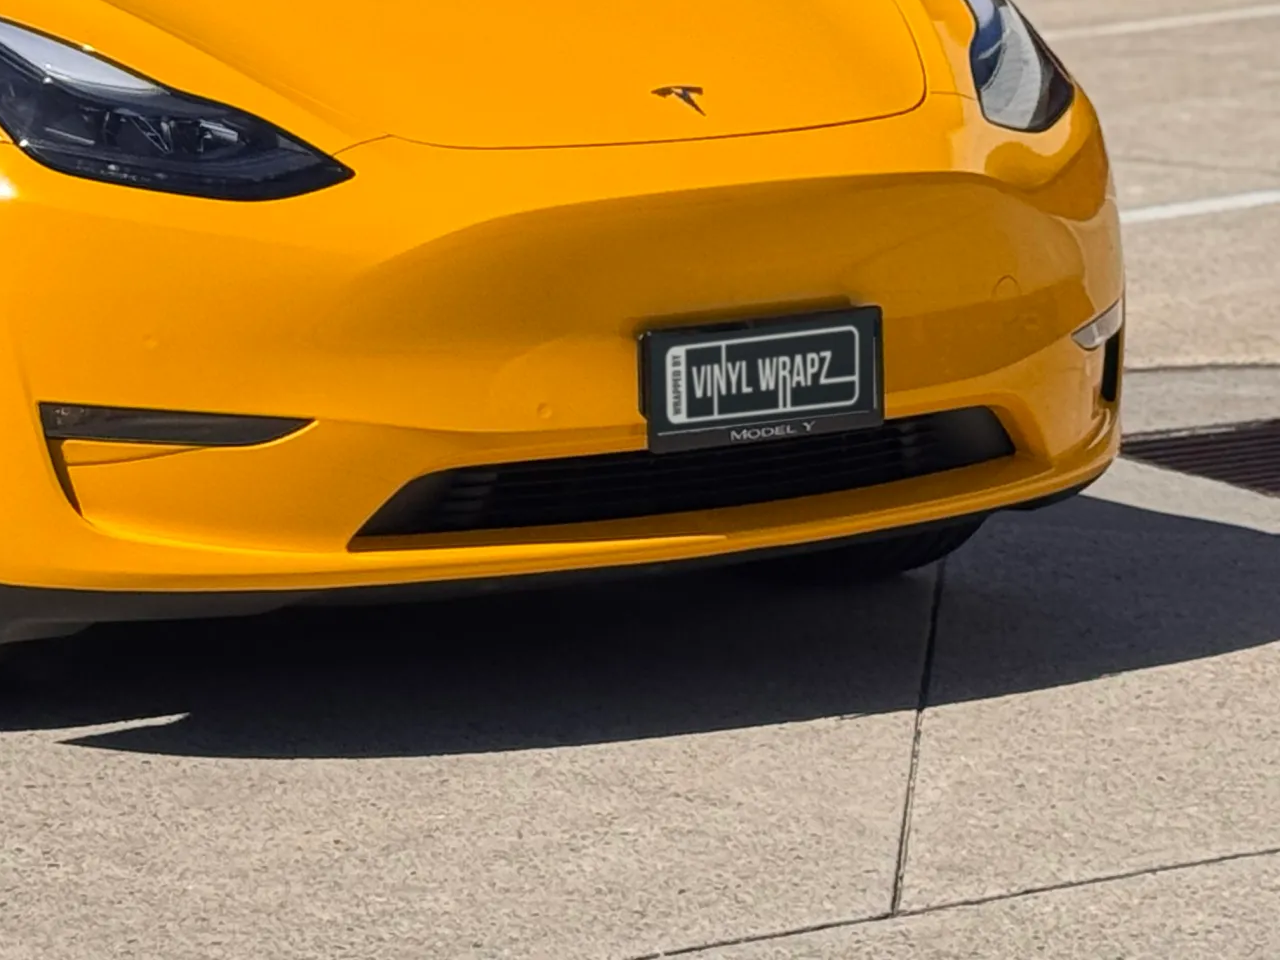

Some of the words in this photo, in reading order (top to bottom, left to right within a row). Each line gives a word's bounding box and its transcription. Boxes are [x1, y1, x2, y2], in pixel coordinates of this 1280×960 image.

[671, 355, 681, 367] BY
[691, 358, 753, 401] VINYL
[757, 350, 832, 396] WRAPZ
[672, 370, 682, 416] WRAPPED
[730, 424, 796, 441] MODEL
[802, 420, 816, 432] Y
